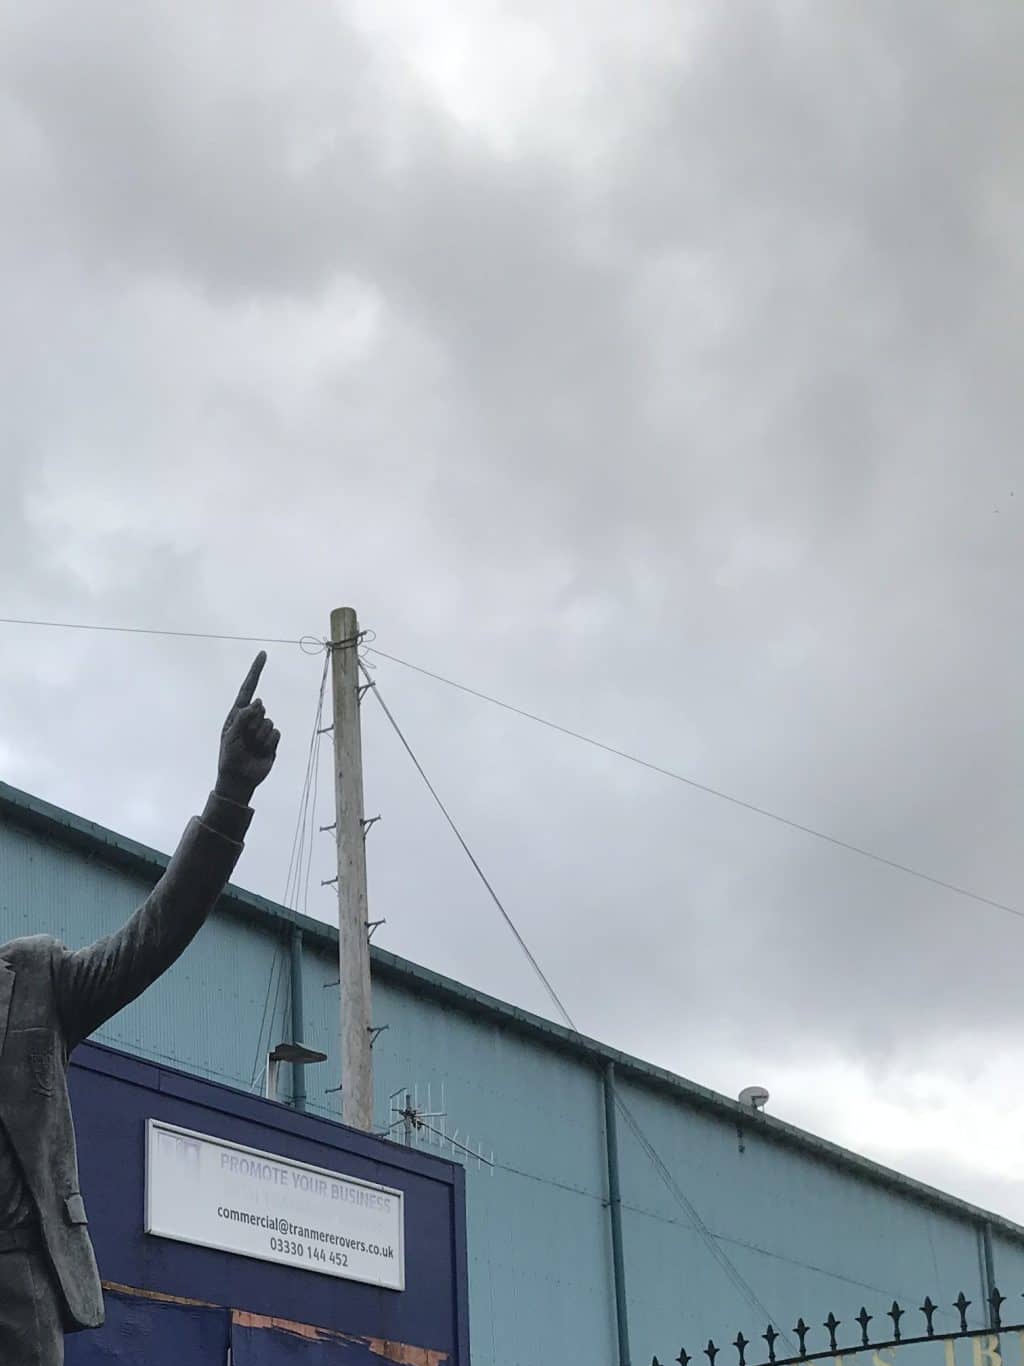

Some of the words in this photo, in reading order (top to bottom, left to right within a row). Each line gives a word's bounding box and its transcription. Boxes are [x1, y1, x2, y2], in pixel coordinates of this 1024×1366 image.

[221, 1152, 289, 1186] PROMOTE
[292, 1171, 327, 1196] YOUR
[331, 1183, 391, 1213] BUSINESS
[217, 1204, 394, 1260] commercial@tranmererovers.co.uk
[270, 1236, 304, 1258] 03330
[306, 1245, 327, 1263] 144
[328, 1249, 349, 1267] 452
